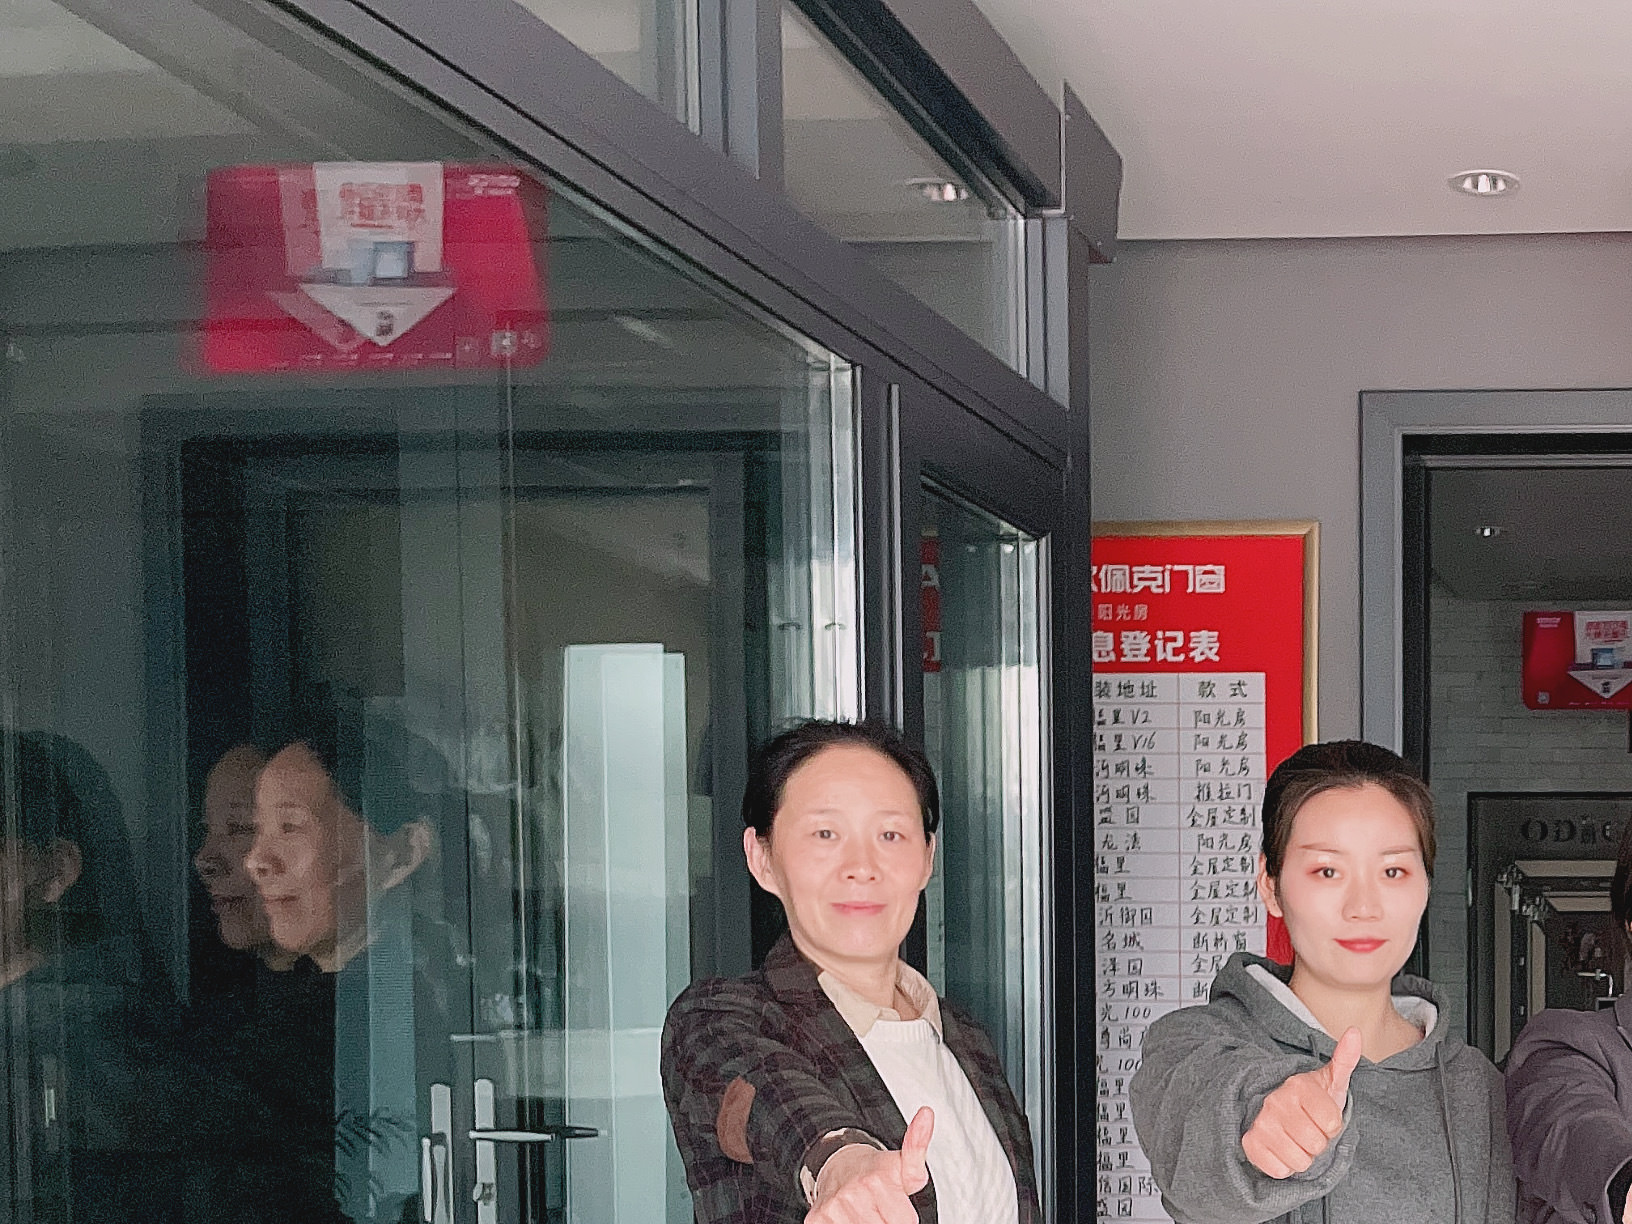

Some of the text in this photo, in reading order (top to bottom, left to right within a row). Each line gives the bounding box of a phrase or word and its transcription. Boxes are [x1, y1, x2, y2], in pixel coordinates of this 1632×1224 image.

[1098, 603, 1148, 621] 阳光房
[1092, 630, 1220, 663] 息登记表
[1198, 680, 1248, 698] 款式
[1194, 708, 1247, 729] 阳光房
[1194, 731, 1249, 750] 阳光房
[1196, 757, 1251, 777] 阳光房
[1195, 782, 1253, 802] 推拉门
[1187, 805, 1256, 828] 全屋定制
[1197, 832, 1253, 853] 阳光房
[1190, 855, 1255, 876] 全屋定制
[1190, 905, 1258, 926] 全屋定制
